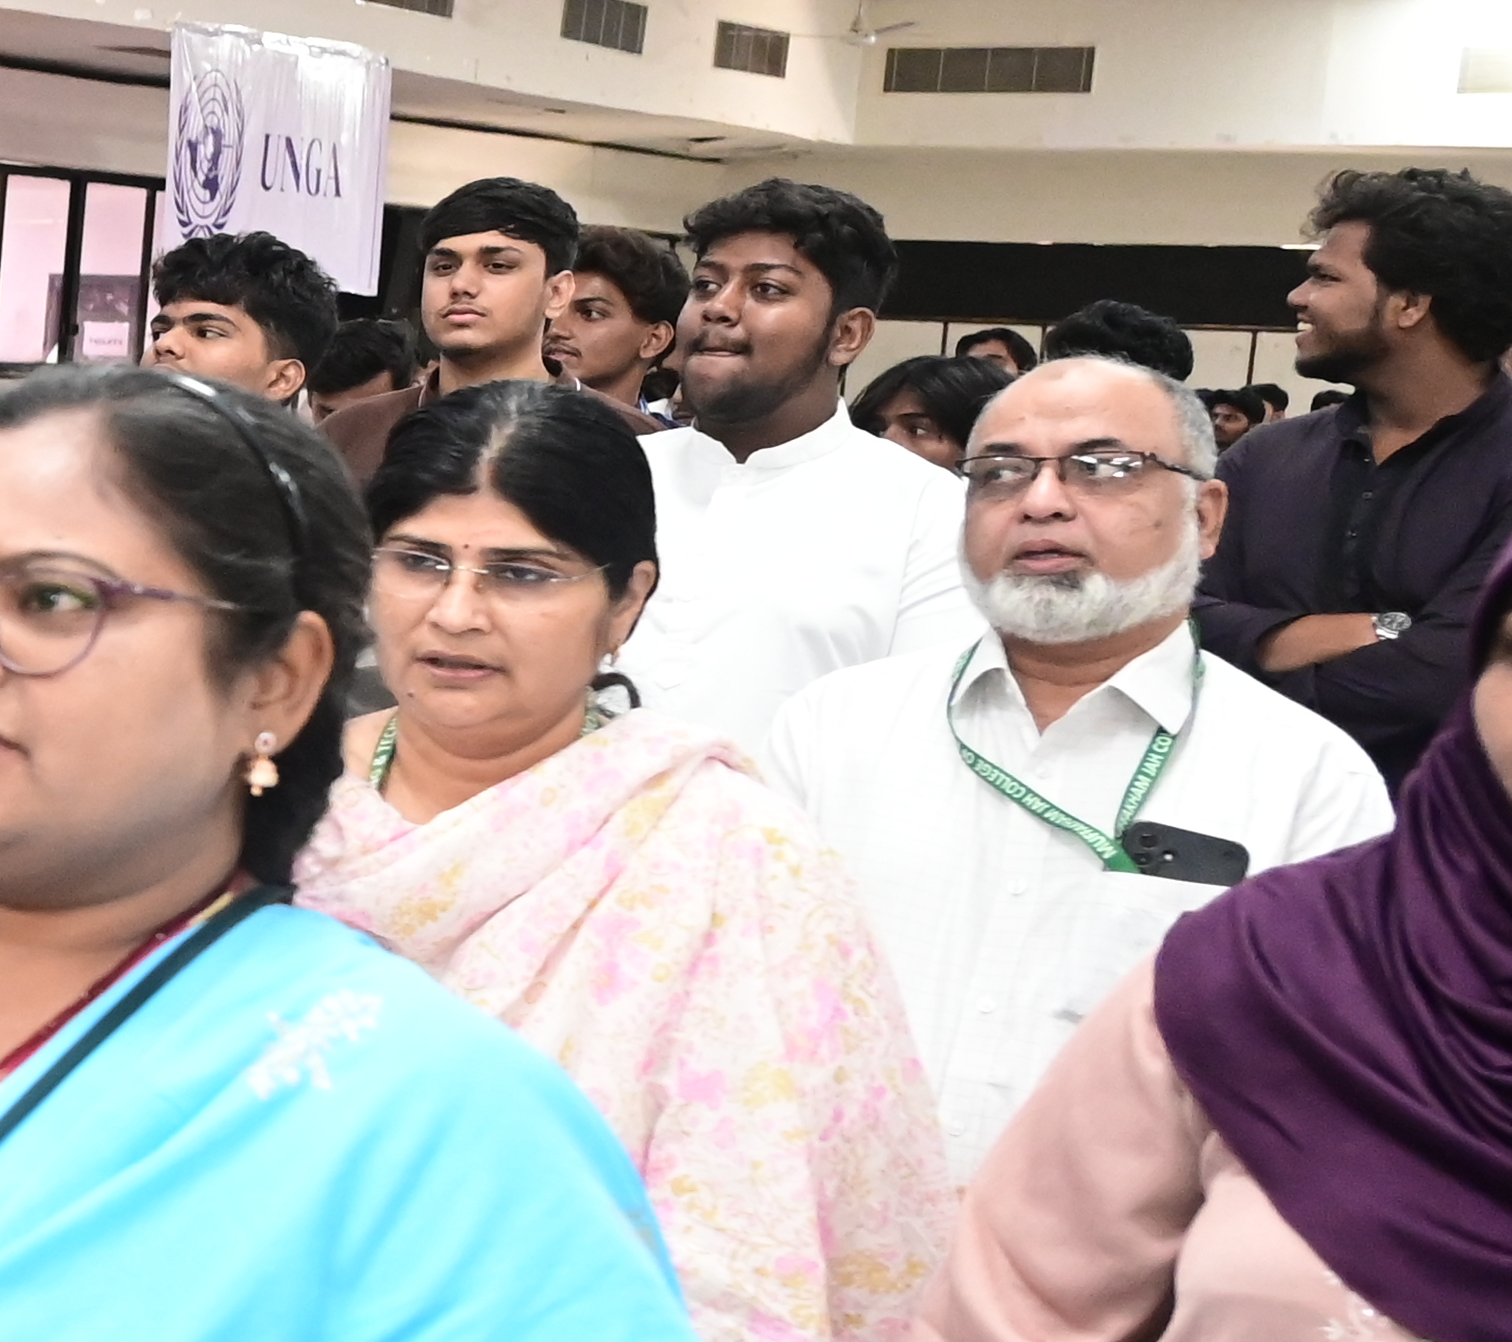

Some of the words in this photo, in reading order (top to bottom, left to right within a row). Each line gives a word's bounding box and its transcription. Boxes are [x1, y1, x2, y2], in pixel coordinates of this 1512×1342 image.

[260, 133, 342, 198] UNGA
[1152, 733, 1173, 753] CO
[973, 759, 1026, 798] COLLEGE
[1141, 753, 1164, 777] JAH
